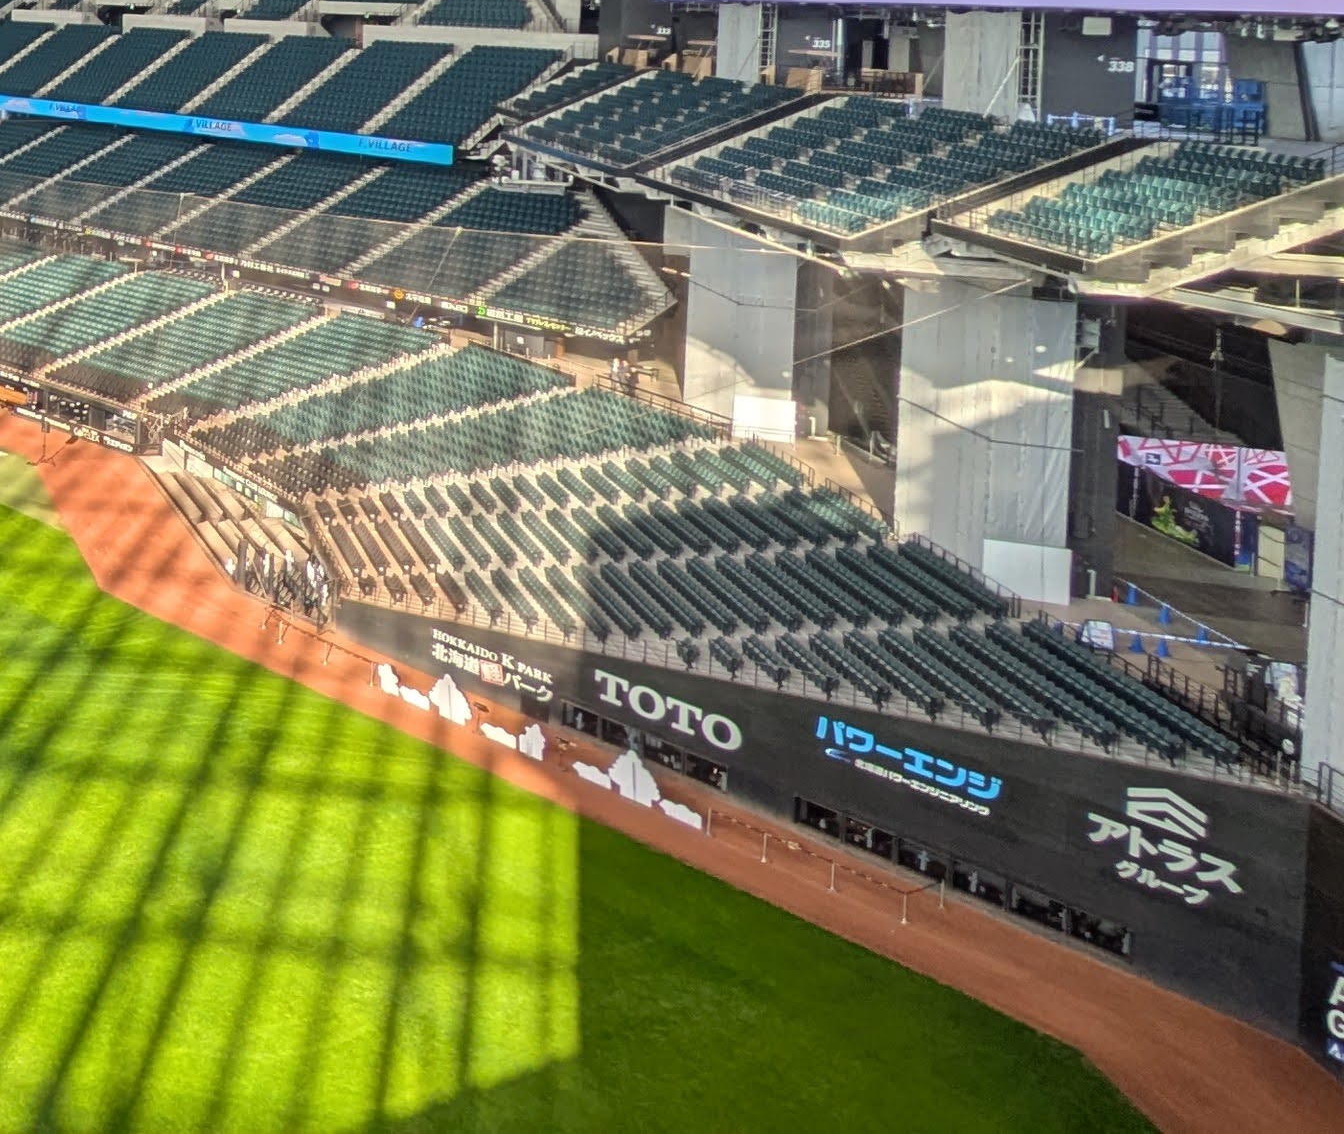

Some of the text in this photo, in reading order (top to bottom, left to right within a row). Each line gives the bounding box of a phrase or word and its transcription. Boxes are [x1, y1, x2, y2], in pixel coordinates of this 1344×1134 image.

[432, 627, 554, 685] HOKKAIDO K PARK
[594, 668, 743, 751] TOTO
[815, 715, 1003, 801] パワーエンジ
[1087, 811, 1244, 894] アトラス
[1114, 859, 1210, 905] グループ
